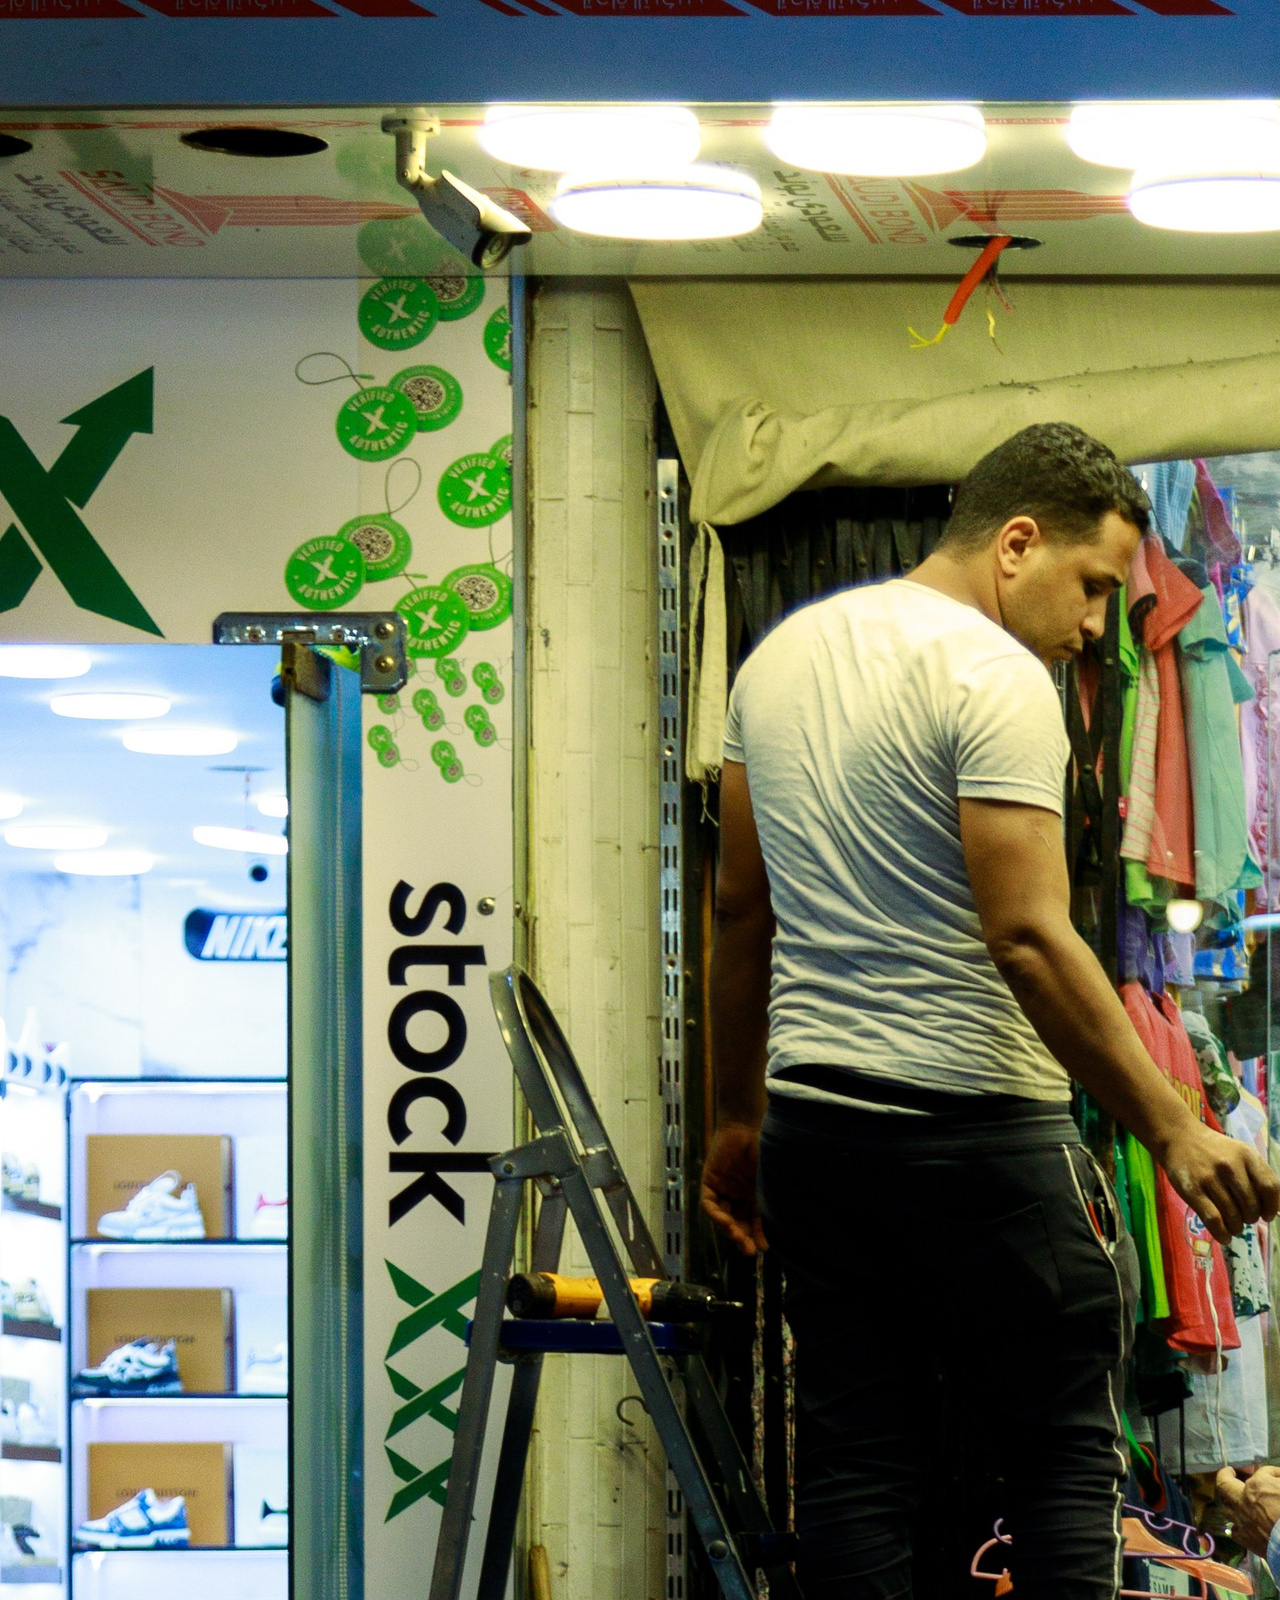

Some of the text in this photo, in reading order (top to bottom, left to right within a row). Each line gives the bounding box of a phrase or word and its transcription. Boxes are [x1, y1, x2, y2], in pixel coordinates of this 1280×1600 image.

[846, 175, 905, 208] AUDI
[368, 278, 417, 302] VERIFIED
[346, 389, 396, 413] VERIFIED
[448, 457, 496, 480] VERIFIED
[296, 539, 345, 563] VERIFIED
[401, 589, 448, 612] VERIFIED
[199, 915, 288, 961] NIKE
[387, 878, 497, 1229] stock
